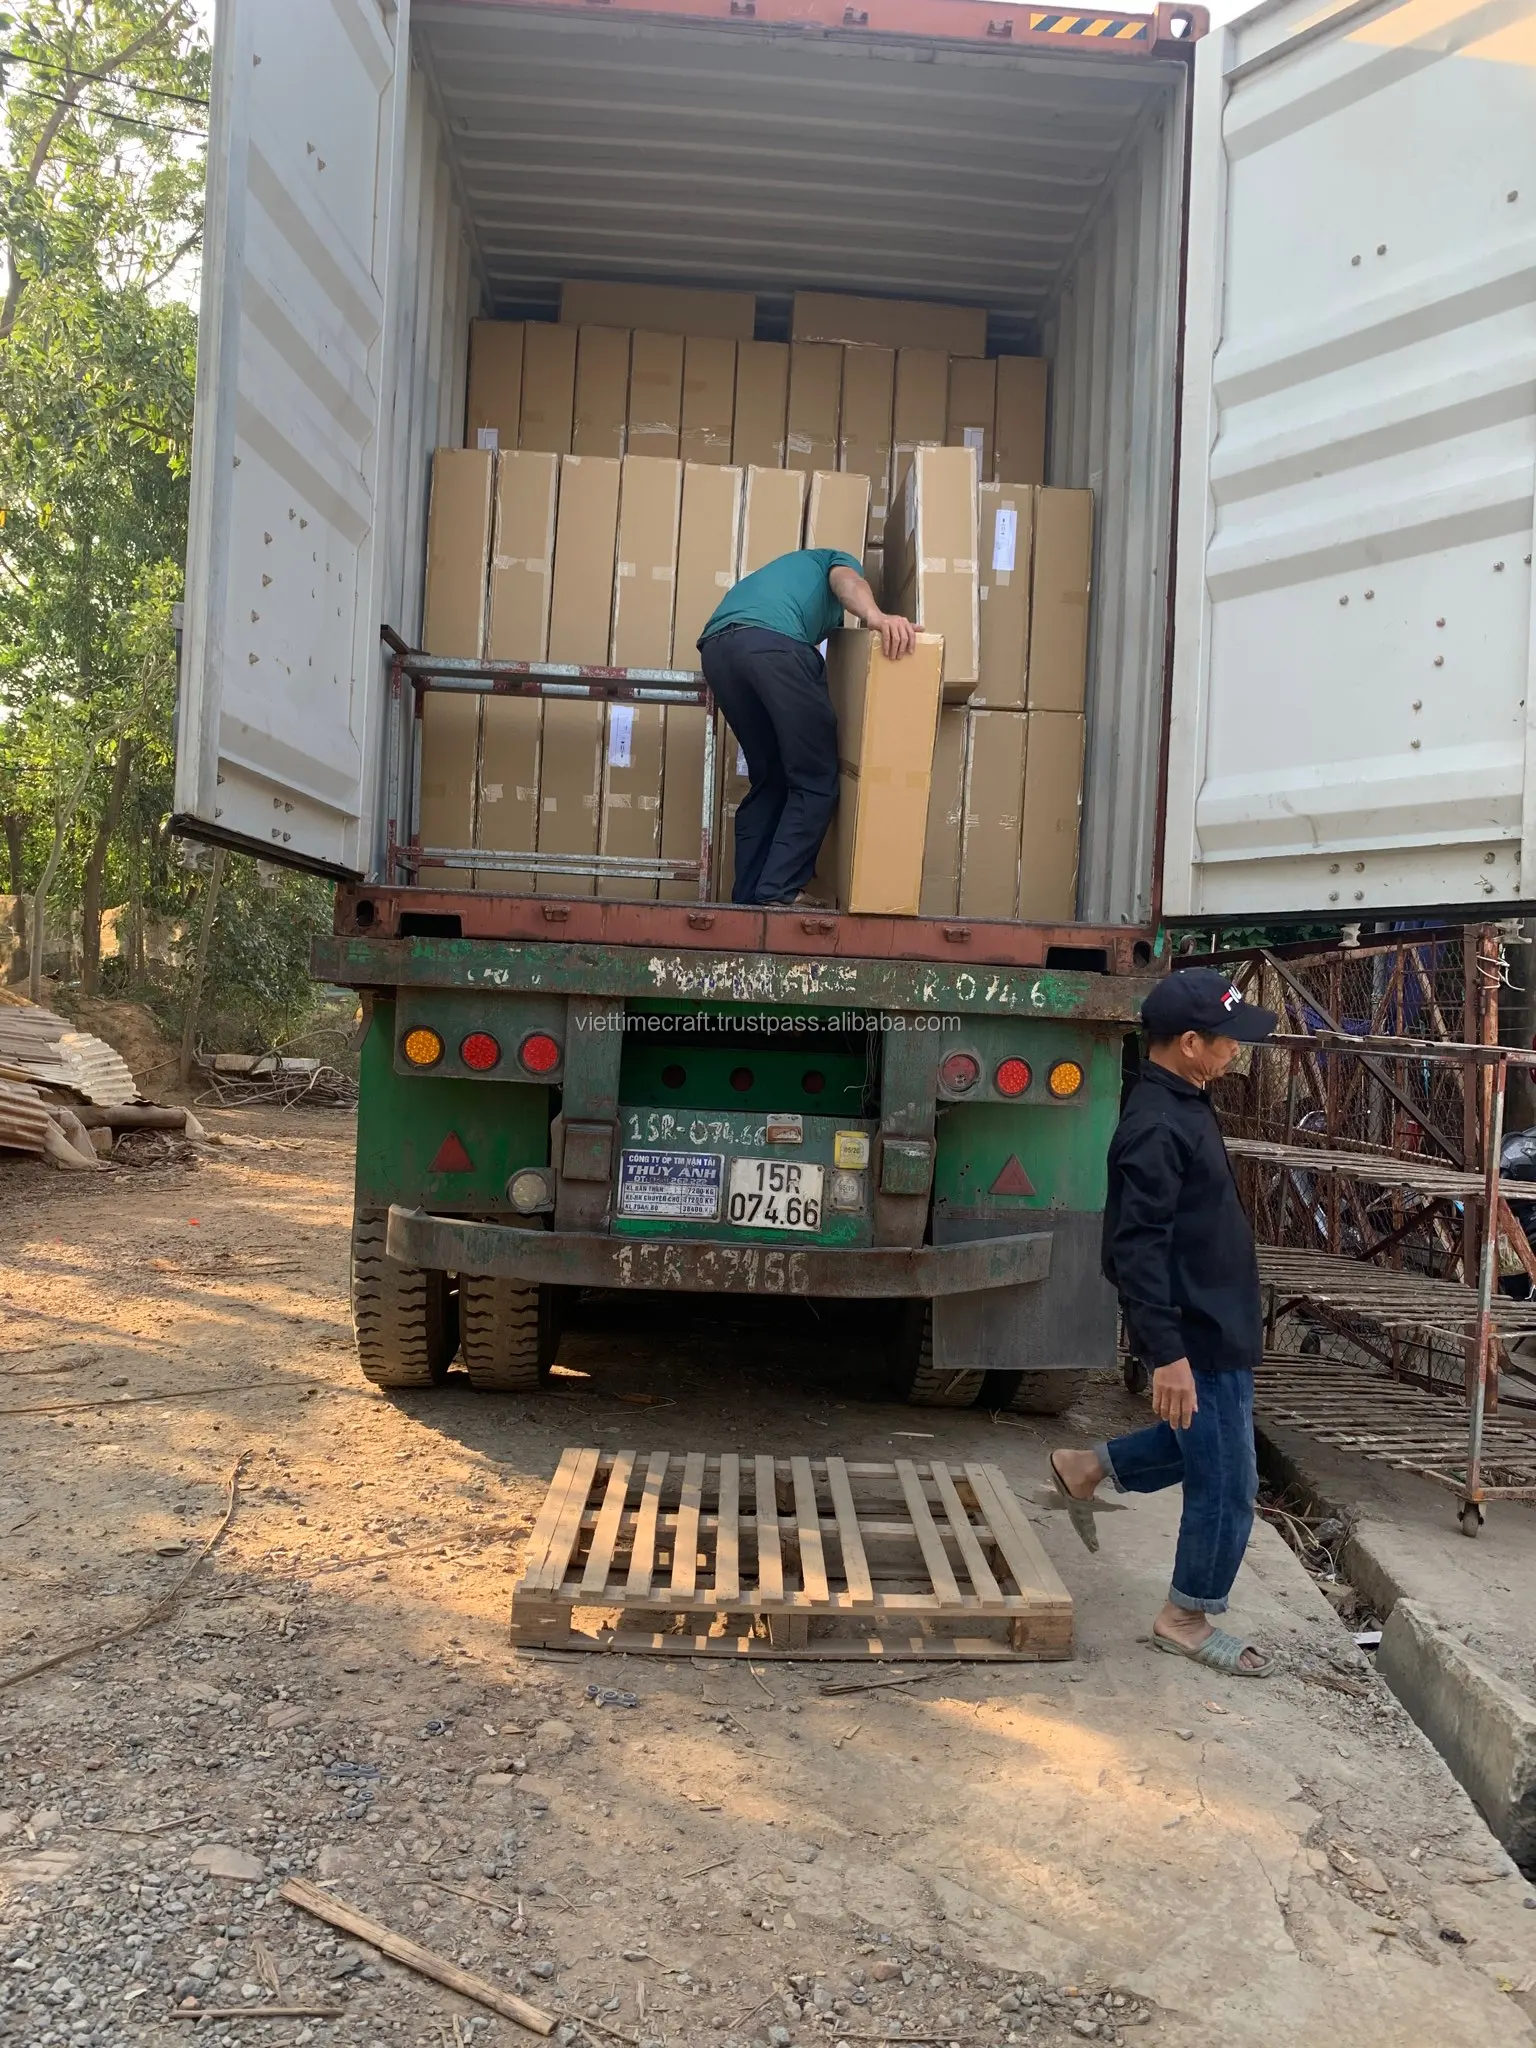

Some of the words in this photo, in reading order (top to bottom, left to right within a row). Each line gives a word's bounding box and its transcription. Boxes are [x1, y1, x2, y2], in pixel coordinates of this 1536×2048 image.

[628, 1153, 649, 1163] CÔNG
[674, 1157, 685, 1165] TM
[678, 1167, 717, 1178] ANH
[756, 1162, 802, 1194] 15R
[730, 1193, 819, 1227] 074.66
